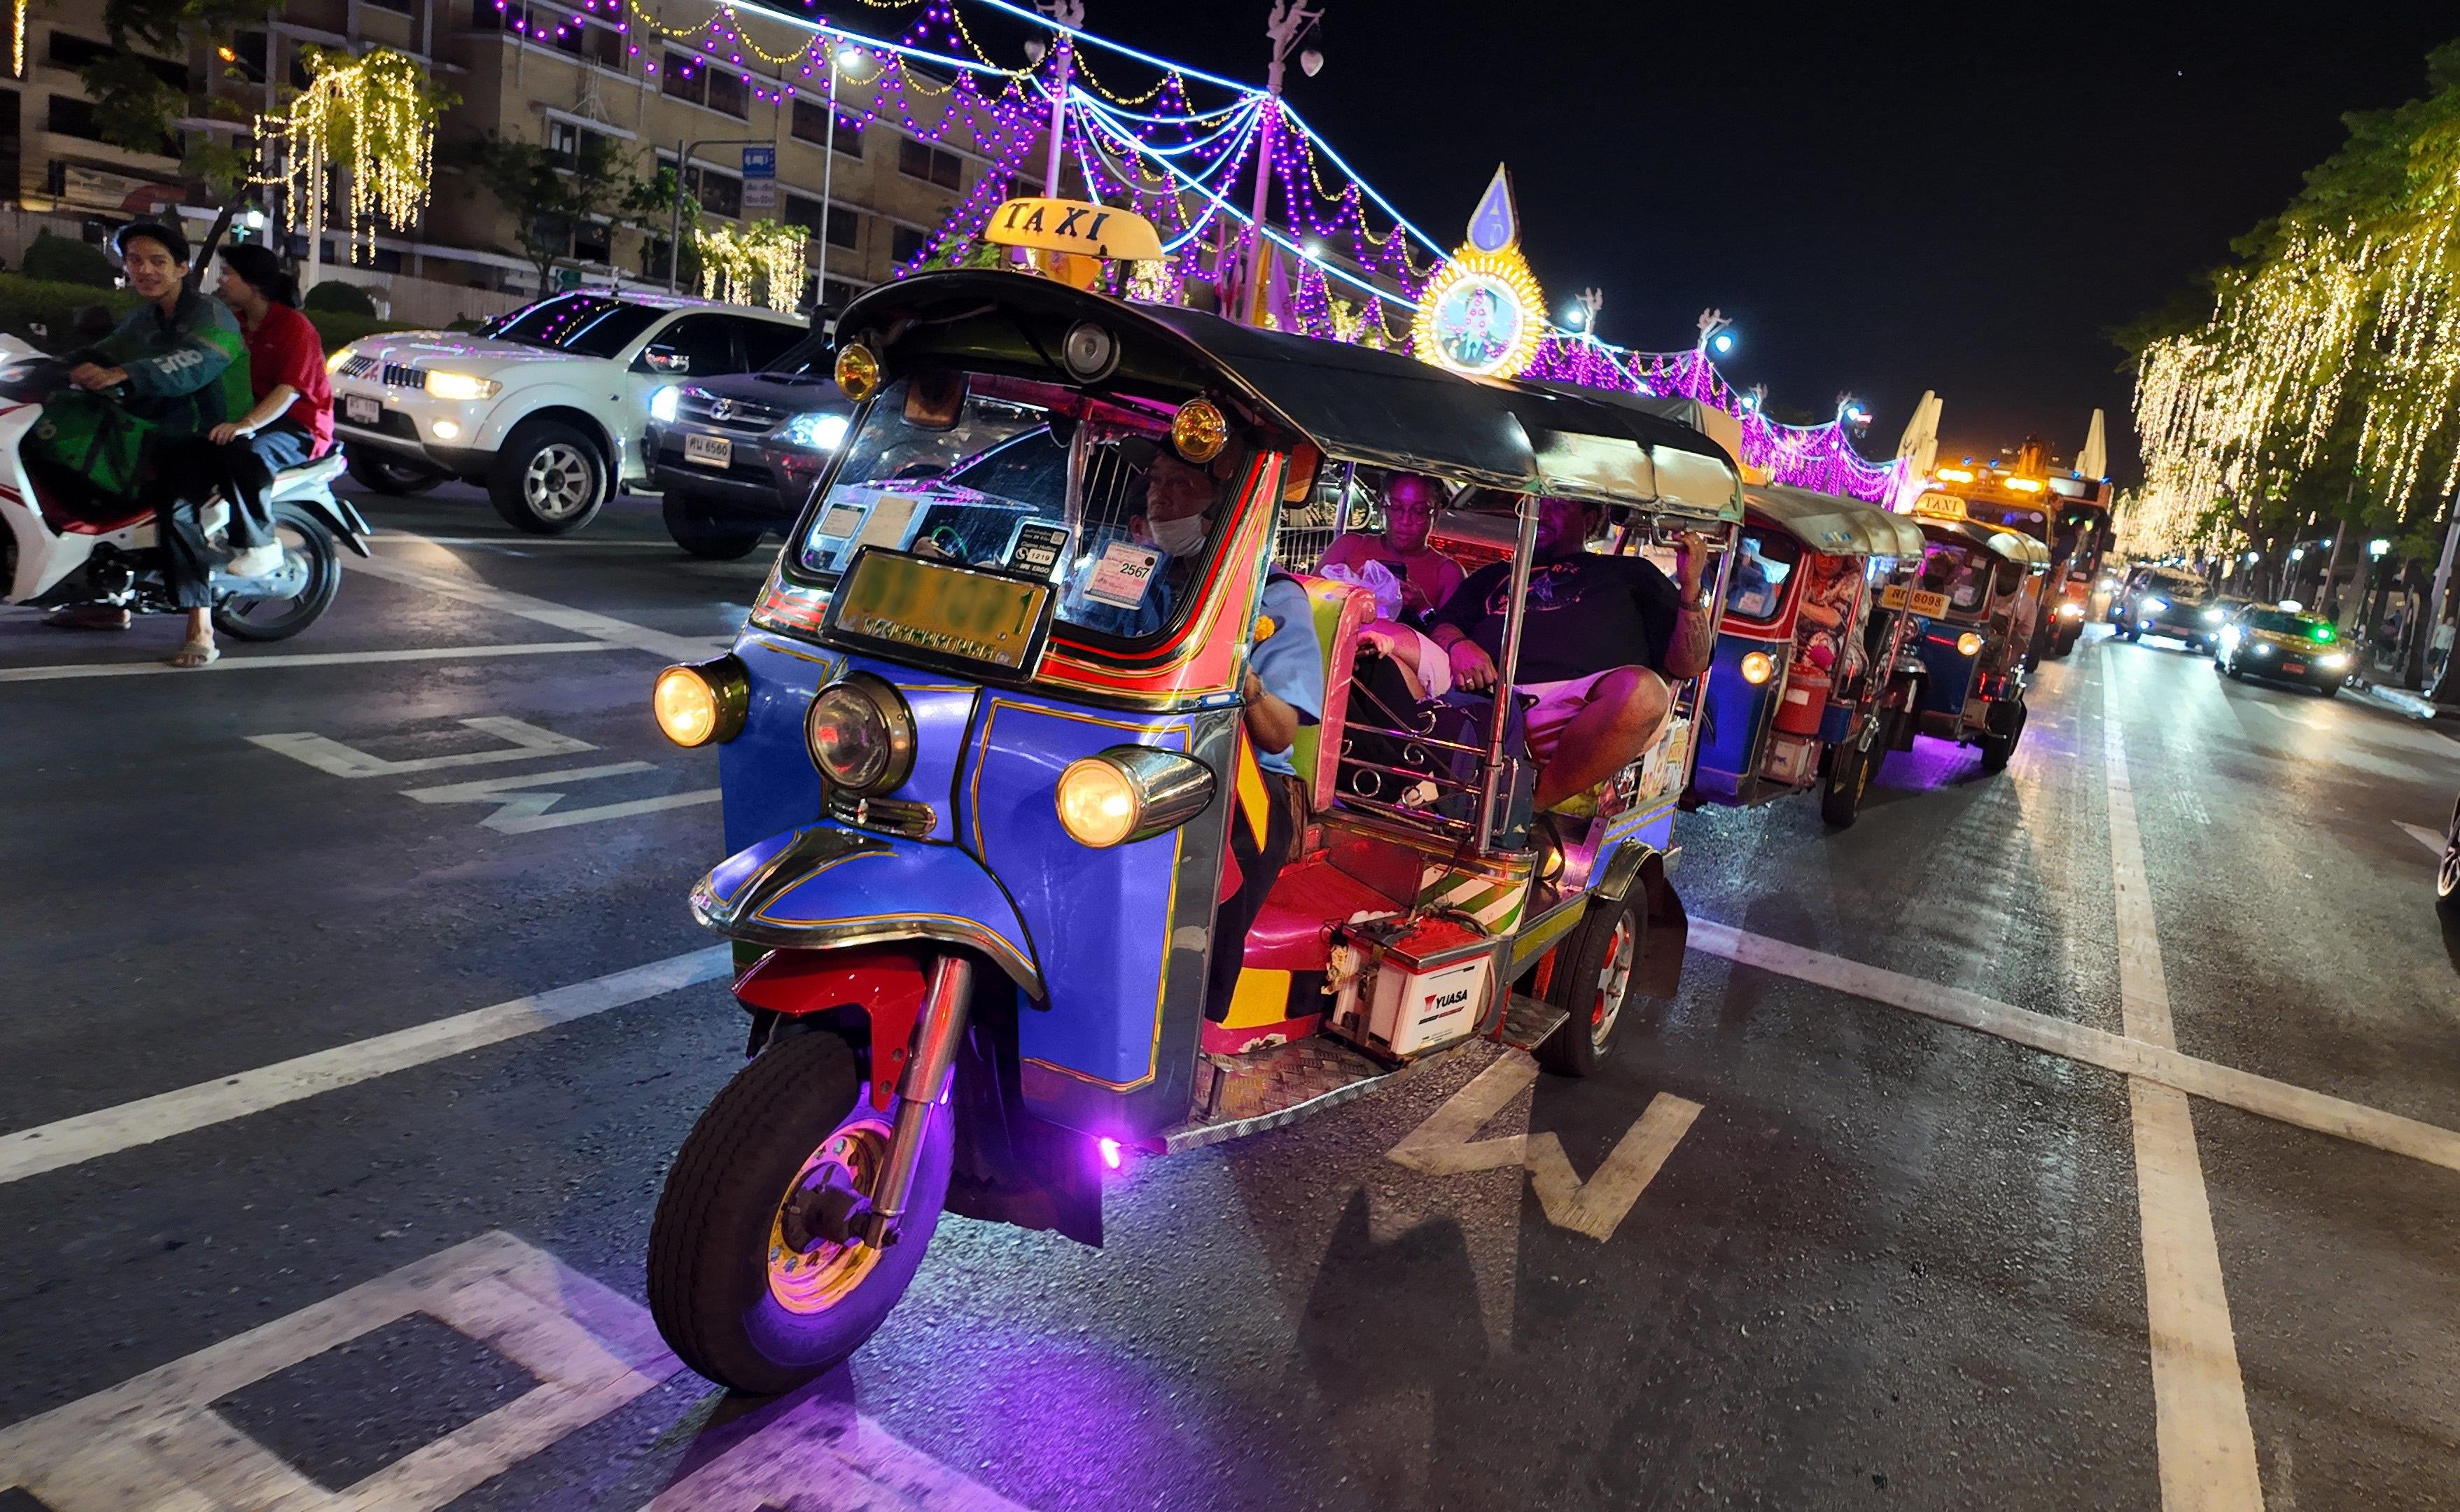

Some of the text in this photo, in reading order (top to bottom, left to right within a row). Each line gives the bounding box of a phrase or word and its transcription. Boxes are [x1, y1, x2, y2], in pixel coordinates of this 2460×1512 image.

[1004, 202, 1110, 241] TAXI
[1119, 562, 1150, 579] 2567
[1913, 592, 1942, 608] 6098
[1435, 989, 1468, 1009] YUASA
